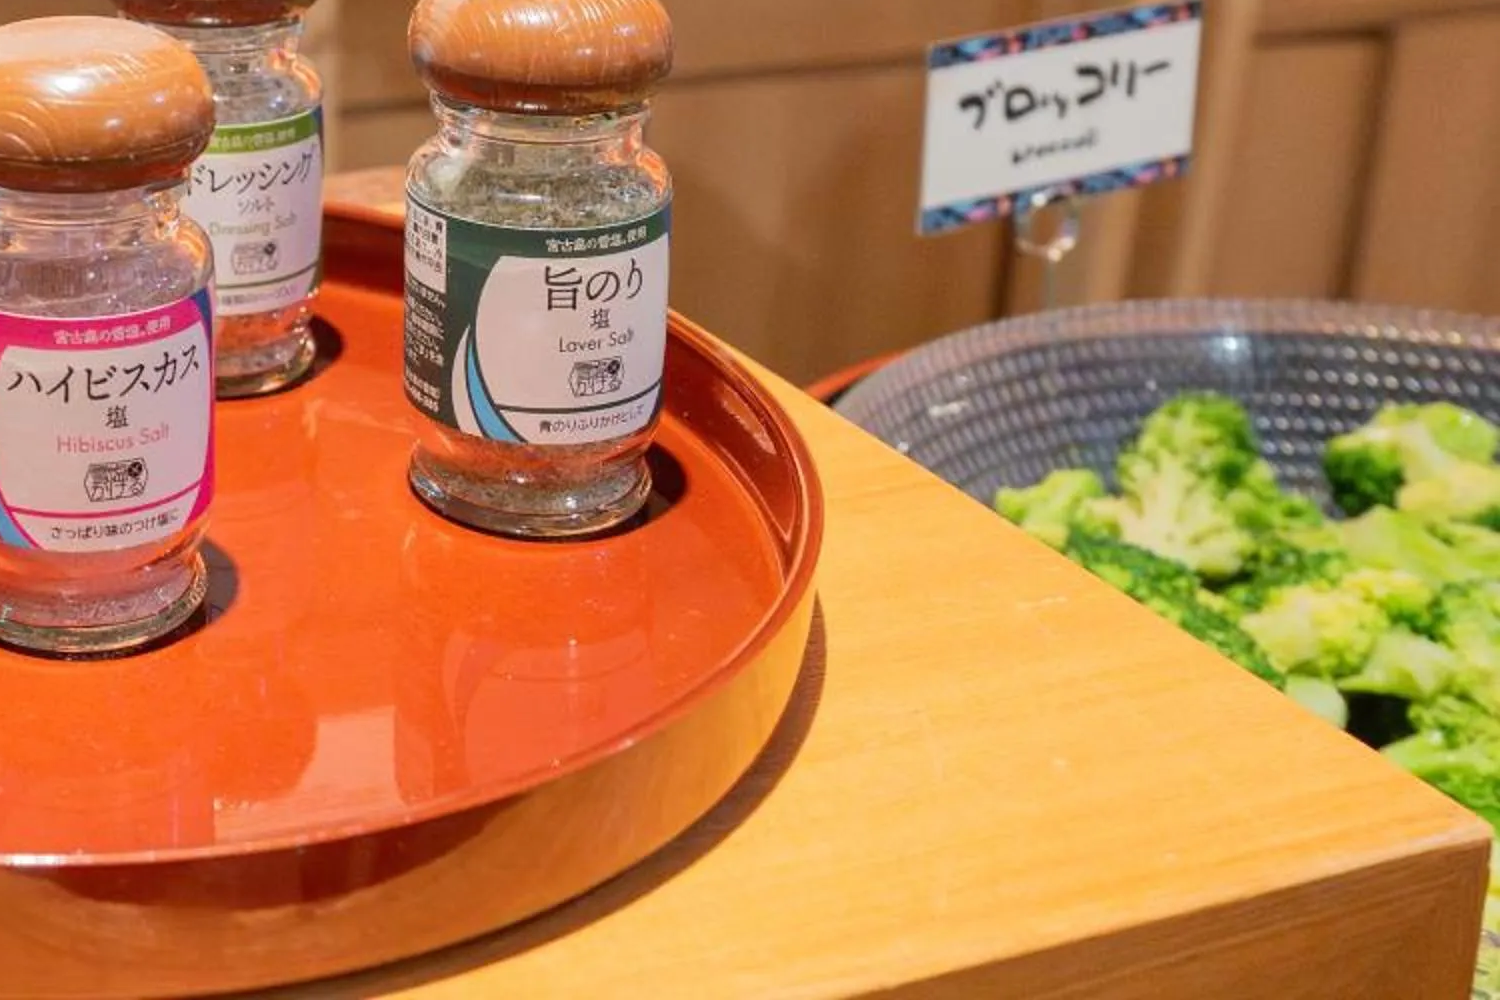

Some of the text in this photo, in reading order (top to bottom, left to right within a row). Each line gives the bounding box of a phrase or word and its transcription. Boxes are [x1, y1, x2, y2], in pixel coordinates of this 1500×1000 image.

[958, 60, 1171, 130] ブロッコリー
[544, 257, 644, 311] 旨のり
[589, 308, 611, 329] 塩
[558, 327, 635, 353] Laver Salt
[7, 345, 199, 403] ハイビスカス
[106, 405, 130, 428] 塩
[56, 423, 170, 454] Hibiscus Salt
